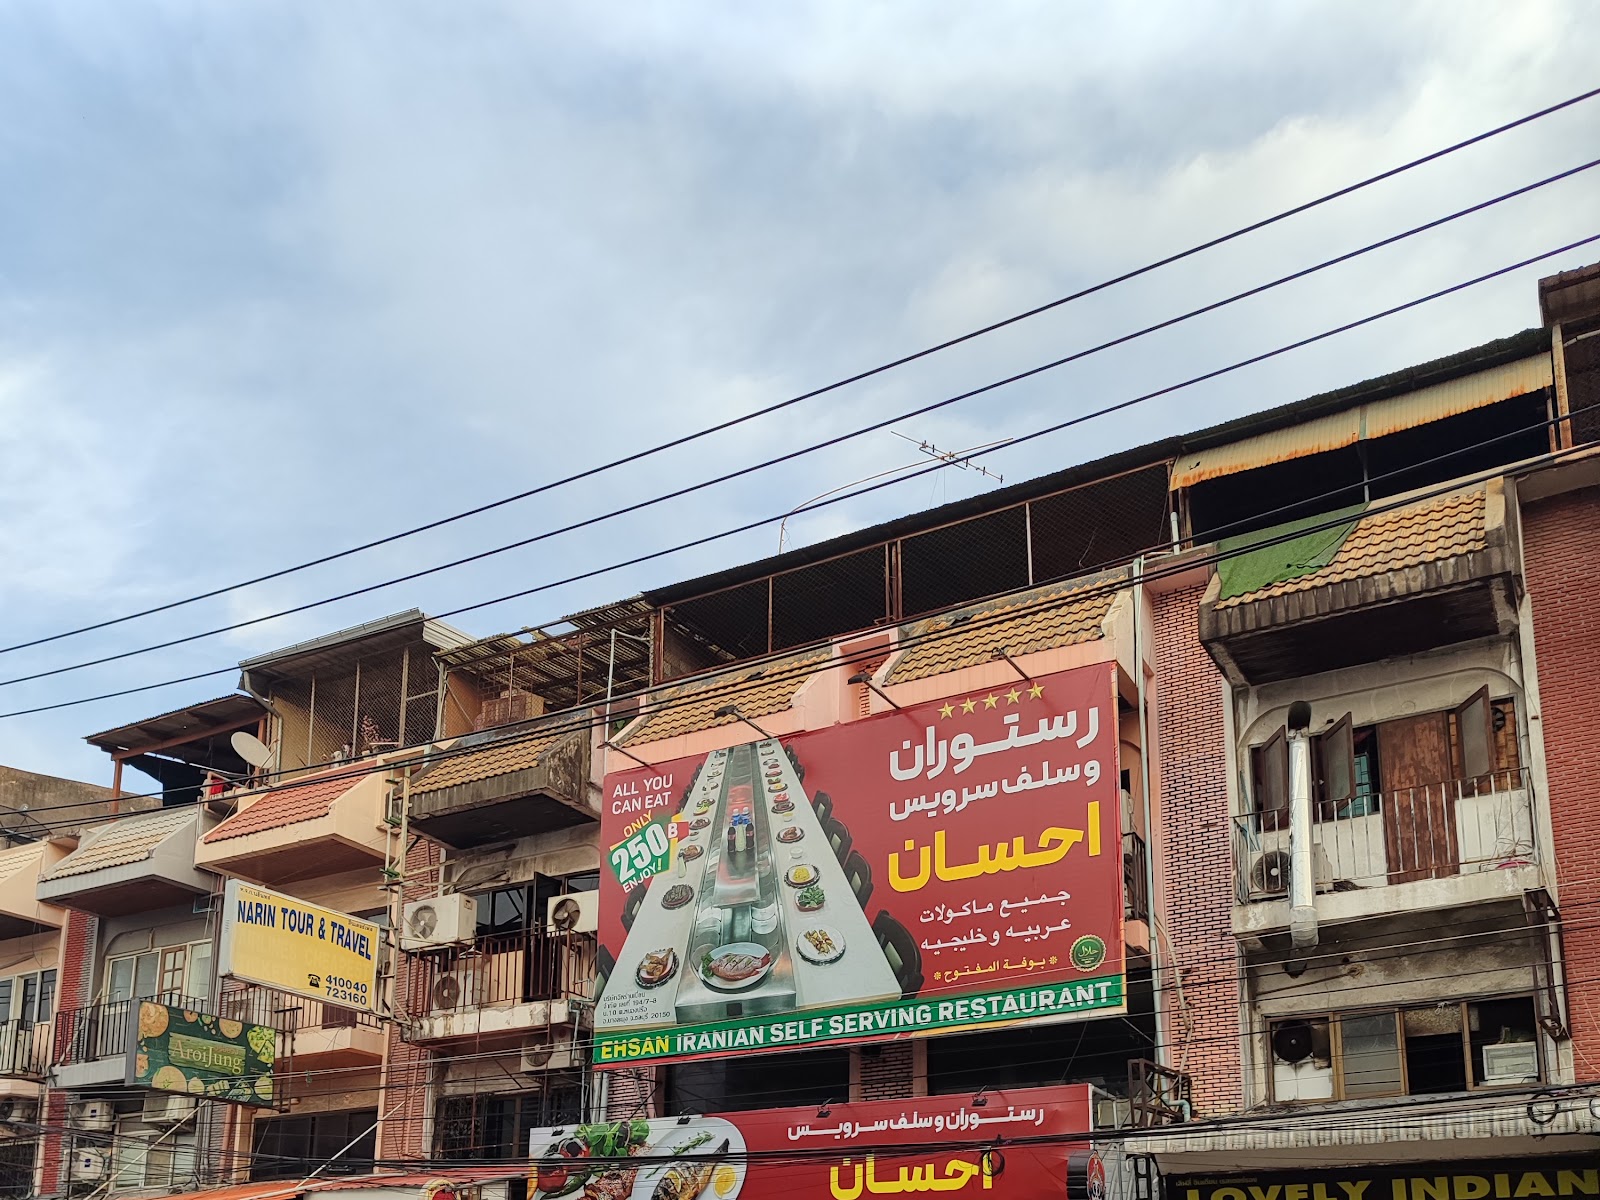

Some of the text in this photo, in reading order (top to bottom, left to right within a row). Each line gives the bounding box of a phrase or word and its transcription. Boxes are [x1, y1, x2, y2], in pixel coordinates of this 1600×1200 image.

[890, 706, 1099, 781] رستوران
[612, 774, 673, 798] ALL YOU
[612, 792, 672, 815] CAN EAT
[623, 810, 653, 838] ONLY
[611, 823, 669, 884] 250
[888, 800, 1101, 892] احسان
[622, 858, 662, 894] ENJOY!
[237, 900, 276, 928] NARIN
[281, 907, 314, 937] TOUR
[318, 917, 326, 941] &
[331, 920, 372, 961] TRAVEL
[325, 974, 368, 994] 410040
[325, 986, 367, 1005] 723160
[601, 981, 1112, 1060] EHSAN IRANIAN SELF SERVING RESTAURANT
[830, 1150, 993, 1200] احسان
[1392, 1169, 1600, 1200] INDIAN
